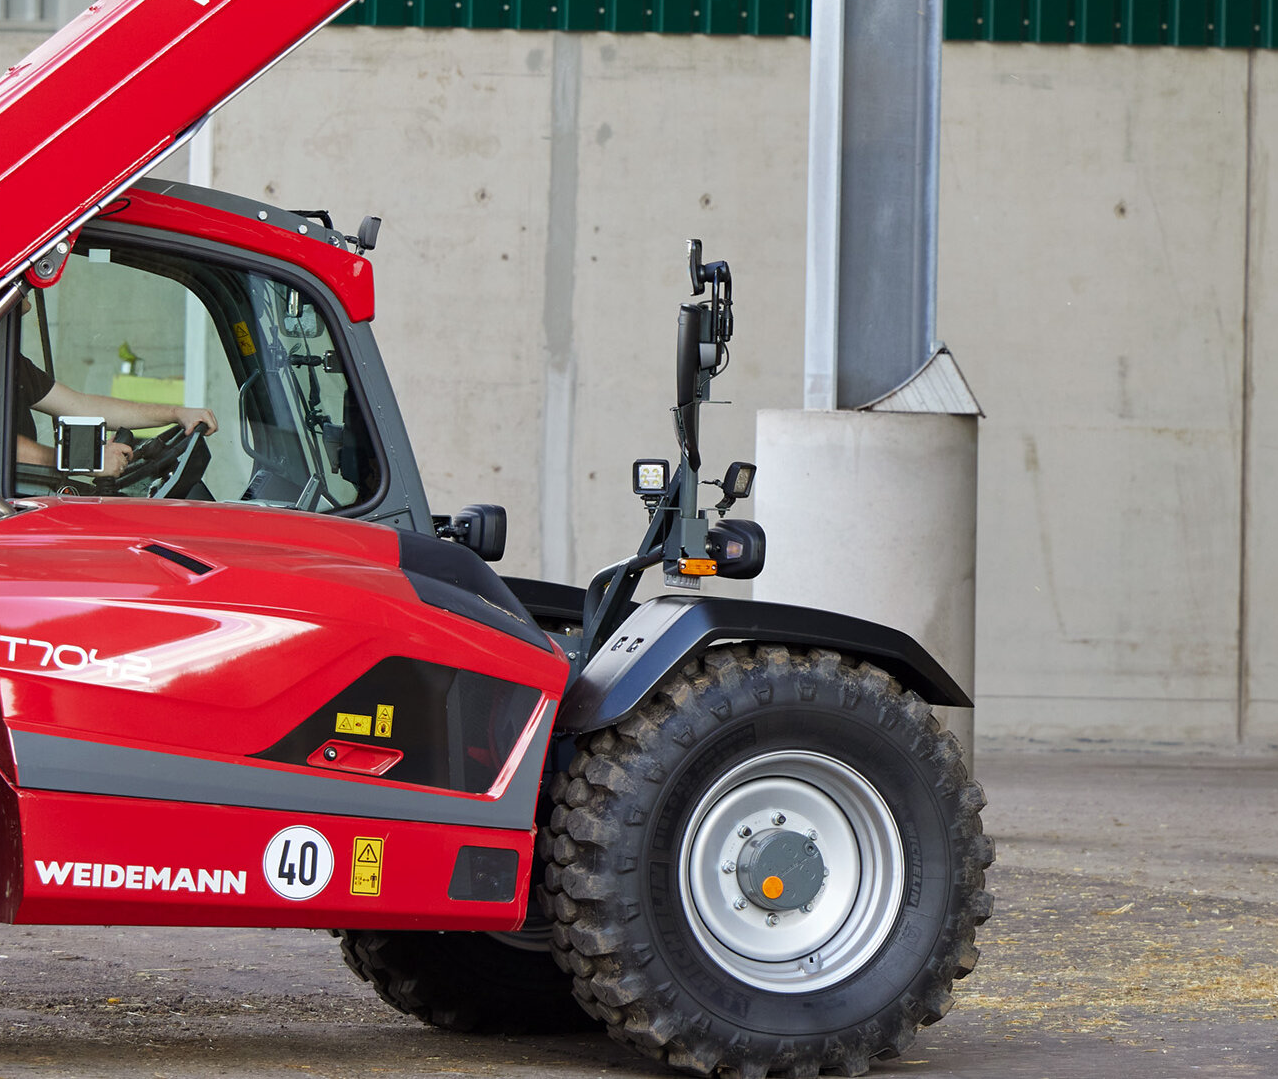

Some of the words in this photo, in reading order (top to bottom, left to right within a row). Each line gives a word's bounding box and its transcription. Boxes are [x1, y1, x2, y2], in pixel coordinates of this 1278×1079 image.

[0, 635, 152, 683] T7042
[35, 860, 246, 894] WEIDEMANN
[278, 840, 317, 886] 40
[905, 820, 921, 906] MICHELIN
